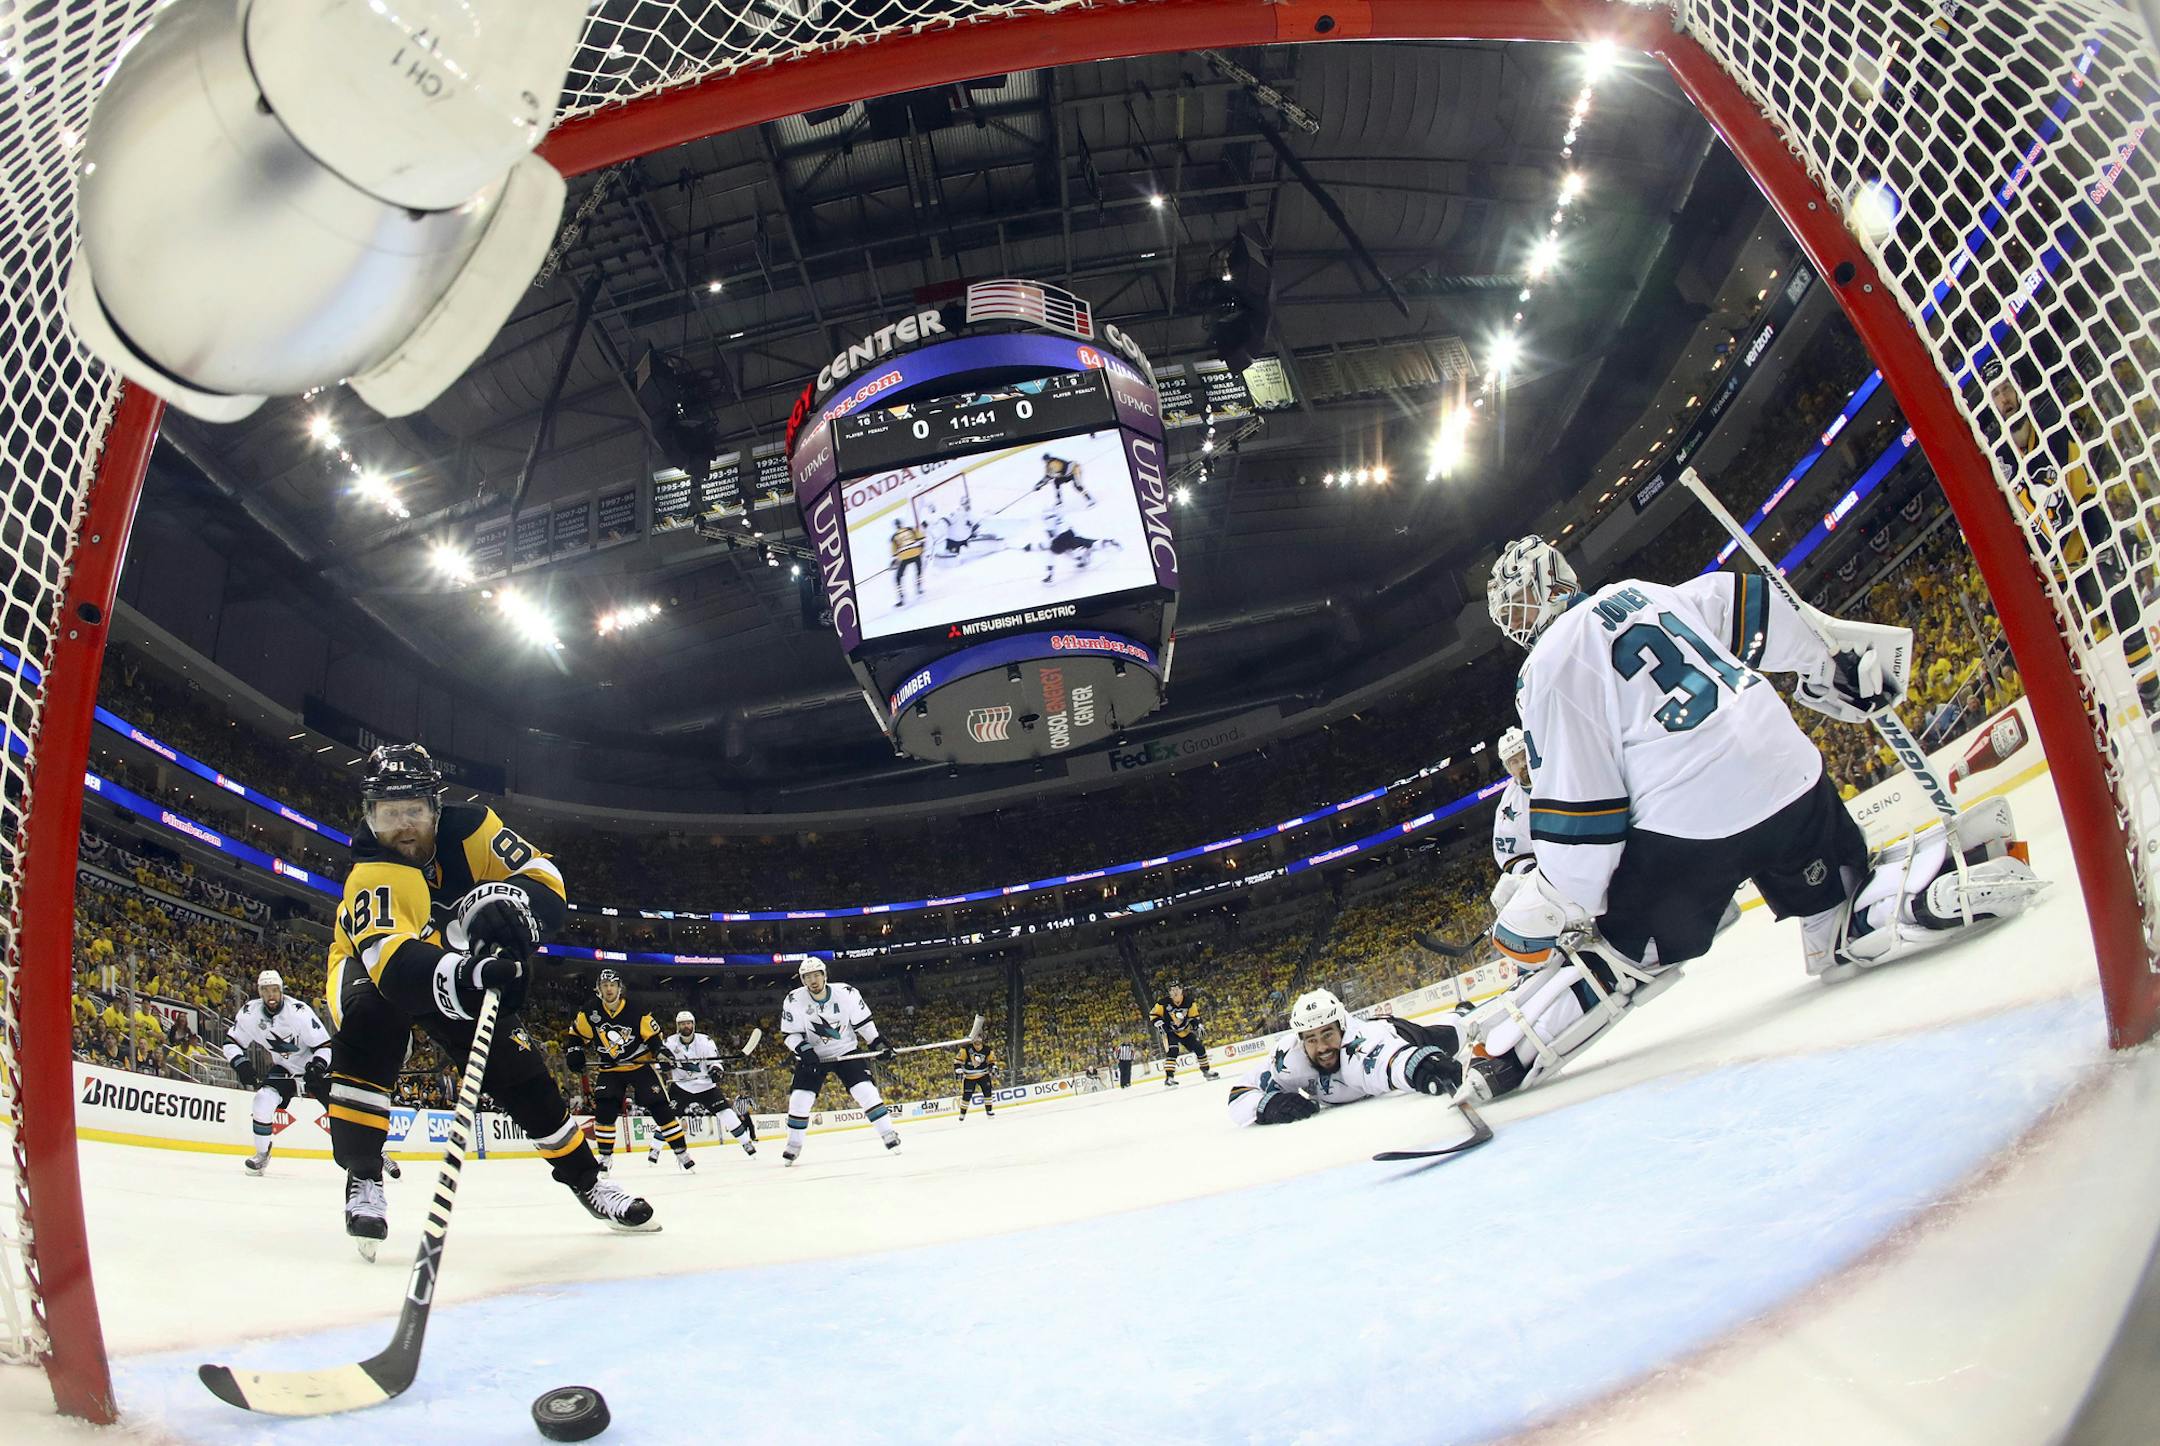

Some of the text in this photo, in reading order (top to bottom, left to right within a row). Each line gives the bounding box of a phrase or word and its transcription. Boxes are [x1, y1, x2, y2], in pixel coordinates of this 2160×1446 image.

[816, 309, 946, 392] CENTER
[1744, 325, 1774, 367] verizon
[1159, 379, 1187, 390] 91-92
[1201, 371, 1240, 384] 1990-9
[1015, 400, 1034, 419] 0
[1117, 391, 1154, 417] UPMC
[1161, 399, 1194, 410] AMPIONS
[912, 410, 996, 440] 0 11:41
[756, 455, 788, 468] 1992-9
[800, 447, 829, 483] UPMC
[657, 479, 691, 493] 1995-96
[706, 484, 735, 495] DIVISION
[756, 477, 790, 489] CHAMPION
[1132, 438, 1179, 574] UPMC
[814, 492, 858, 638] UPMC
[962, 604, 1077, 636] MITSUBISHI ELECTRIC
[1592, 586, 1653, 632] JONES
[1050, 635, 1150, 662] 84lumber.com
[1612, 610, 1763, 733] 31
[896, 670, 932, 707] LUMBER
[1039, 667, 1071, 750] CONSOL ENERGY
[1071, 684, 1095, 728] CENTER
[1108, 726, 1240, 773] FedEx Ground
[389, 760, 406, 772] 81
[1876, 713, 1957, 817] VAUGHN
[1857, 791, 1902, 821] CASINO
[1494, 837, 1517, 854] 27
[352, 884, 397, 937] 81
[1046, 916, 1076, 930] 11:41
[833, 1002, 841, 1014] A
[1306, 1001, 1318, 1011] 46
[1237, 1040, 1266, 1054] LUMBER
[82, 1077, 226, 1124] BRIDGESTONE
[921, 1100, 940, 1111] day
[272, 1110, 289, 1126] KIN
[388, 1114, 410, 1138] SAP
[429, 1117, 451, 1138] SAP
